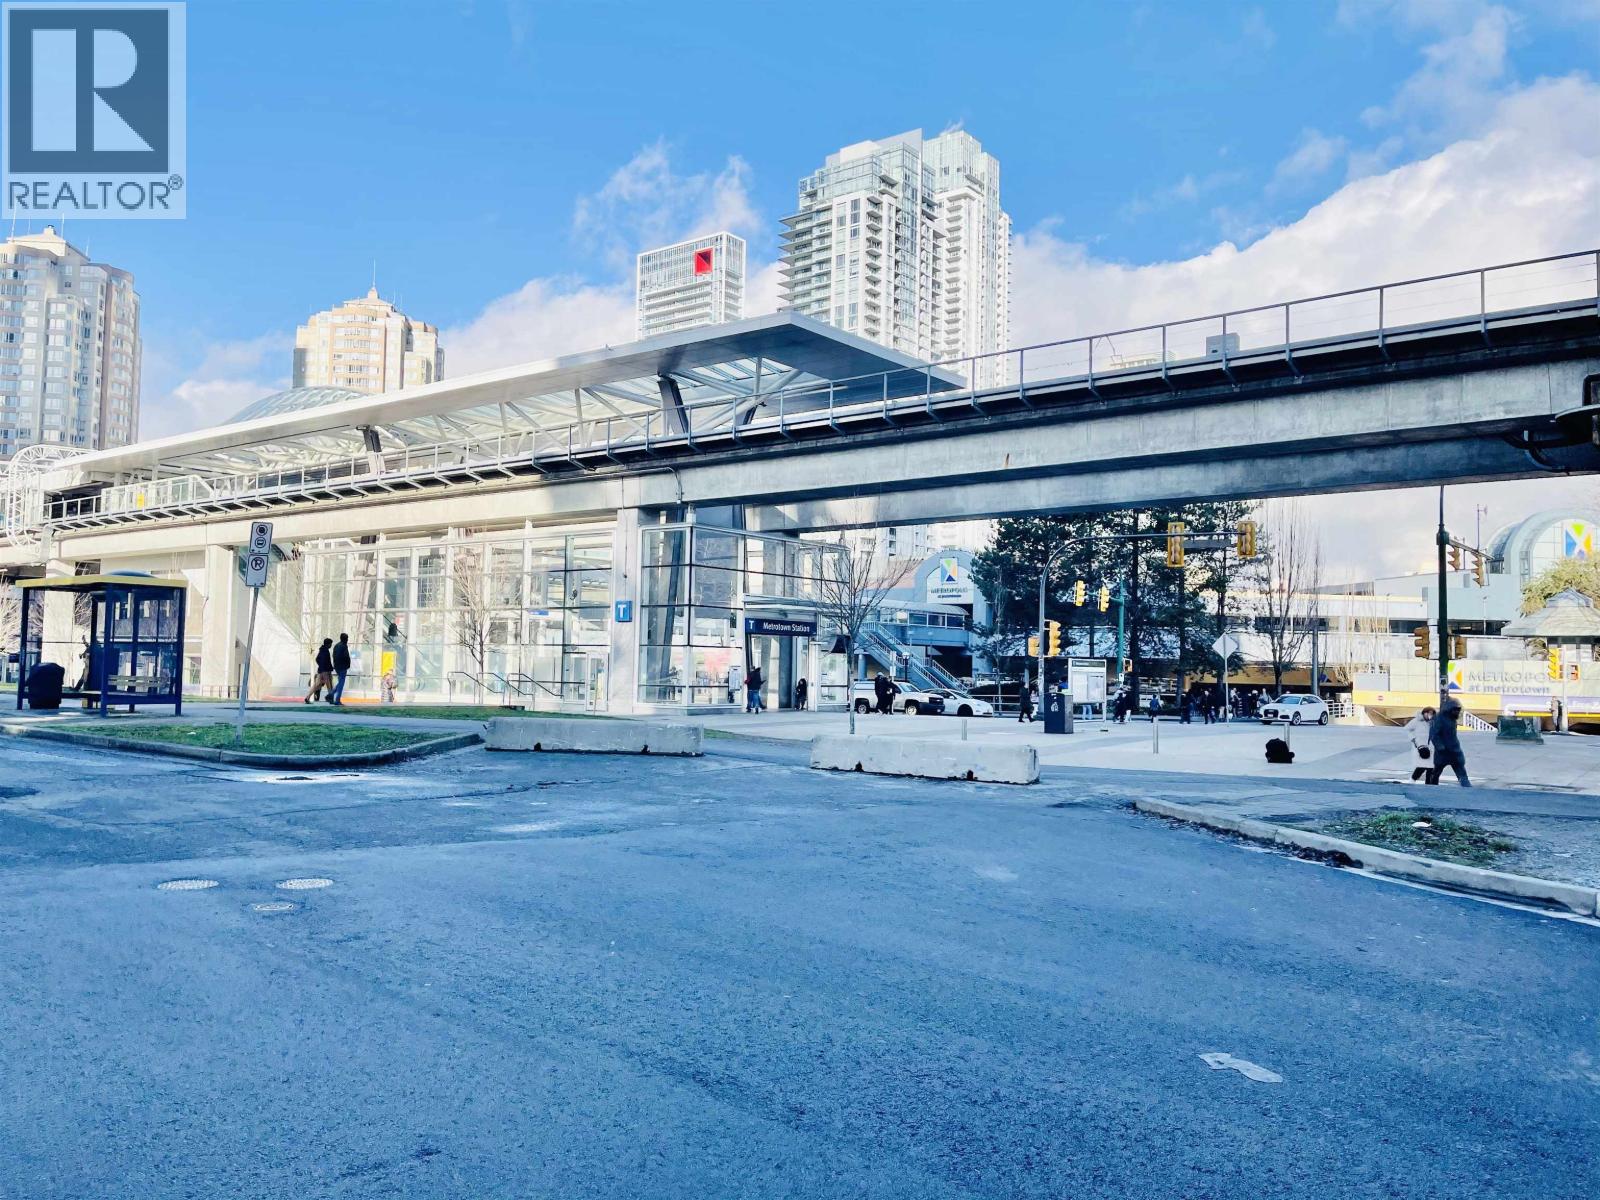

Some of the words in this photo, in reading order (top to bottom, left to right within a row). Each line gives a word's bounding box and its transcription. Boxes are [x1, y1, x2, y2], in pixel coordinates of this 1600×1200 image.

[617, 604, 626, 618] T
[748, 620, 755, 630] T
[762, 622, 791, 631] Metrotown
[791, 623, 810, 632] Station
[1468, 683, 1480, 692] at
[1482, 684, 1551, 694] metrotown
